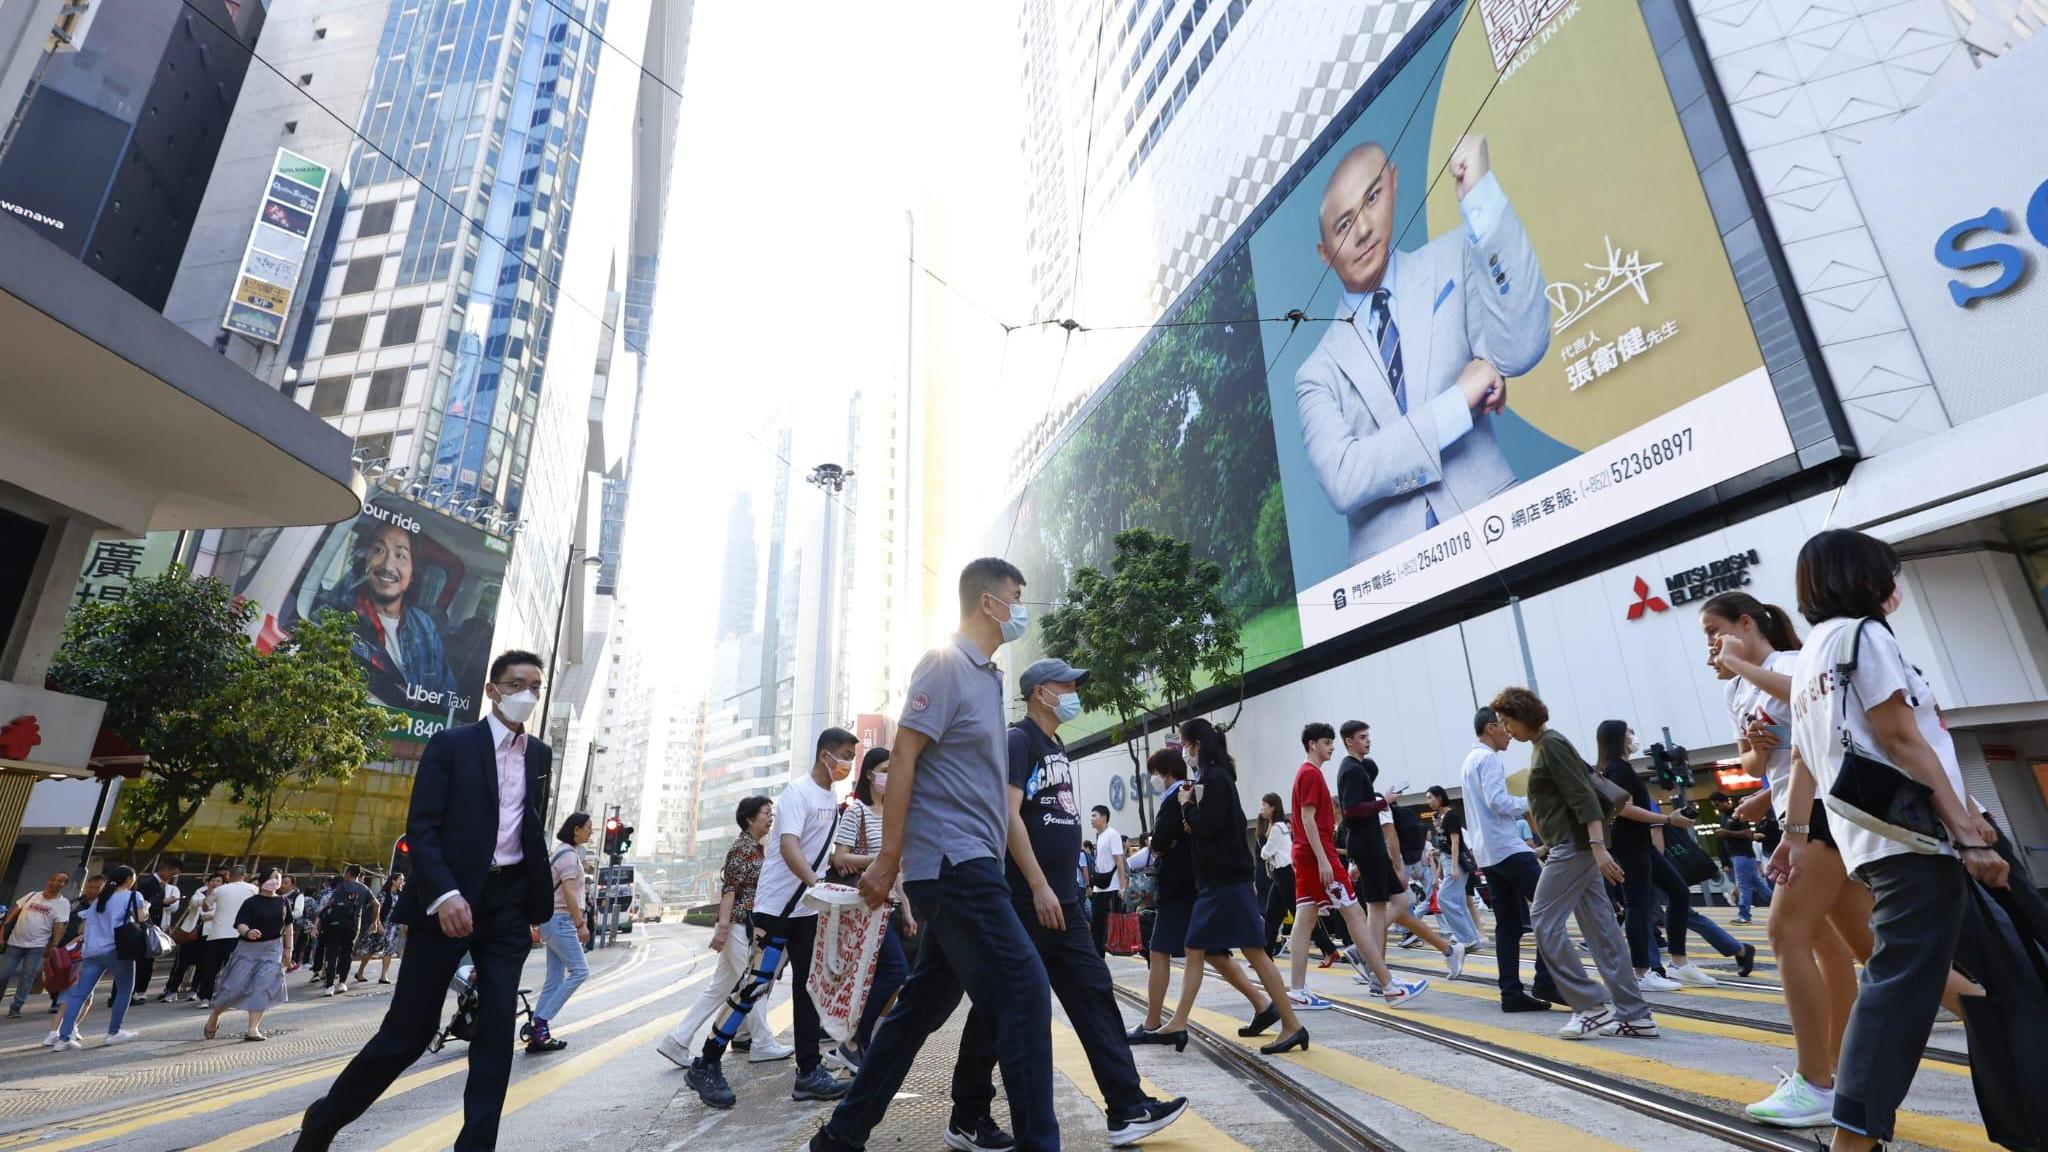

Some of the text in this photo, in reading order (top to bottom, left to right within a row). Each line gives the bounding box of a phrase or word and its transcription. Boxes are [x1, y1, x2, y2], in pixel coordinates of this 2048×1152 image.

[1499, 0, 1582, 85] MADE IN HK
[0, 199, 65, 230] wanawa
[1560, 330, 1601, 362] 代言人
[1610, 427, 1695, 485] 52368897
[391, 509, 421, 534] ride
[1417, 531, 1472, 571] 25431018
[1665, 548, 1761, 592] MITSUBISHI
[1669, 569, 1752, 606] ELECTRIC
[405, 682, 471, 711] Uber Taxi
